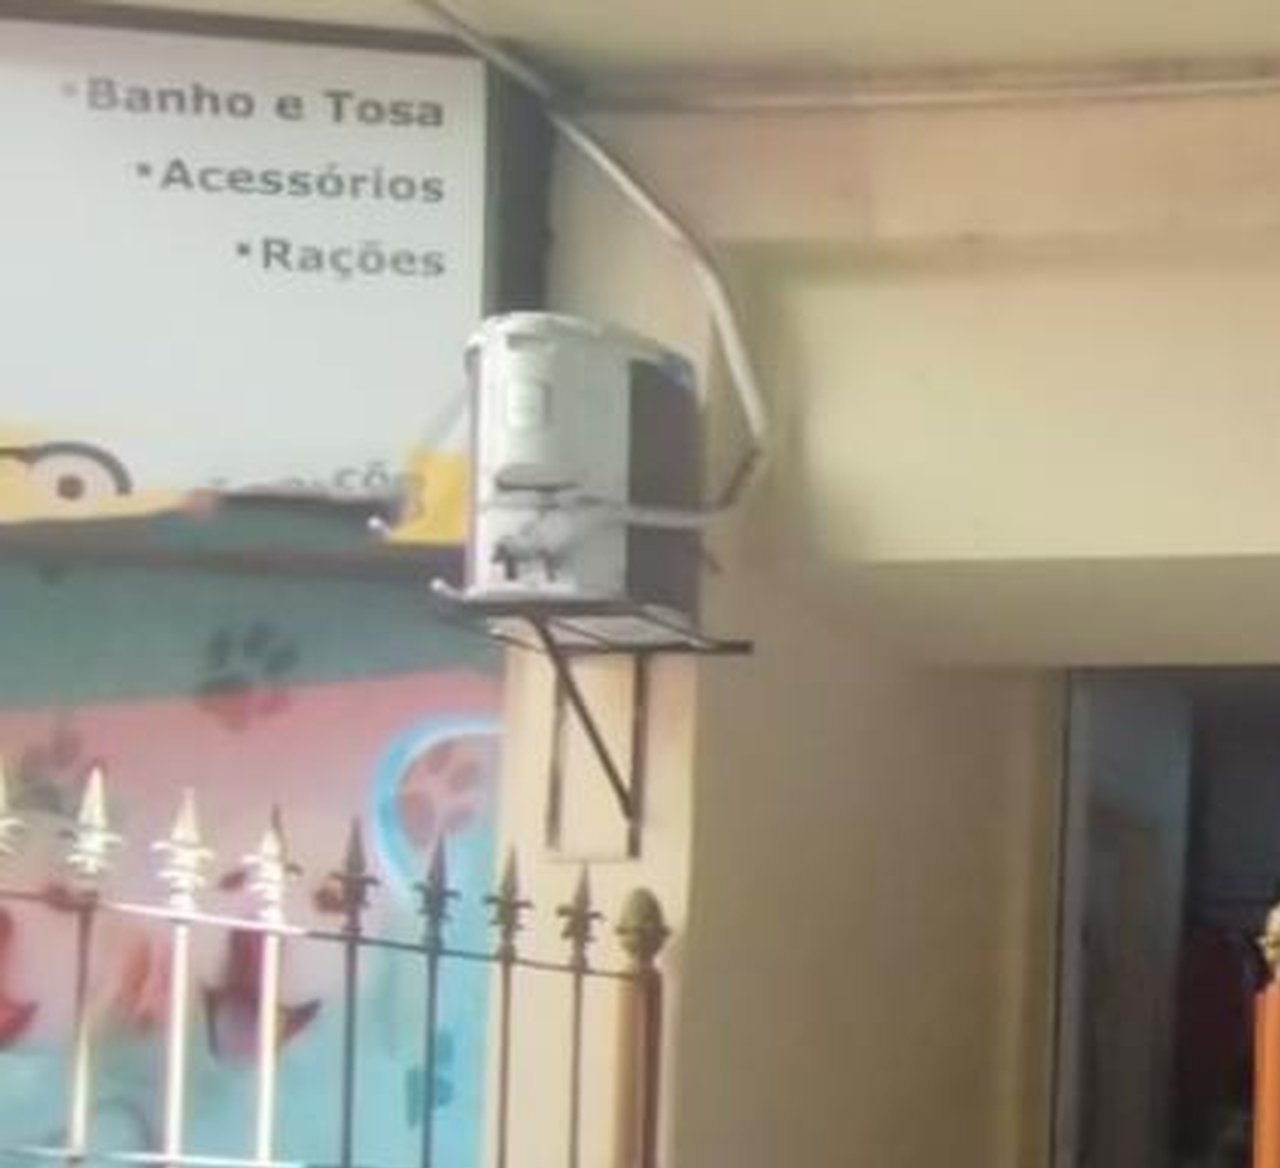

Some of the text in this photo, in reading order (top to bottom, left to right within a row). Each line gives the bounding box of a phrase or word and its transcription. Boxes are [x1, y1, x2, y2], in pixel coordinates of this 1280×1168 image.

[85, 76, 446, 128] Banho e Tosa
[160, 157, 447, 204] Acessórios
[261, 236, 447, 281] Rações
